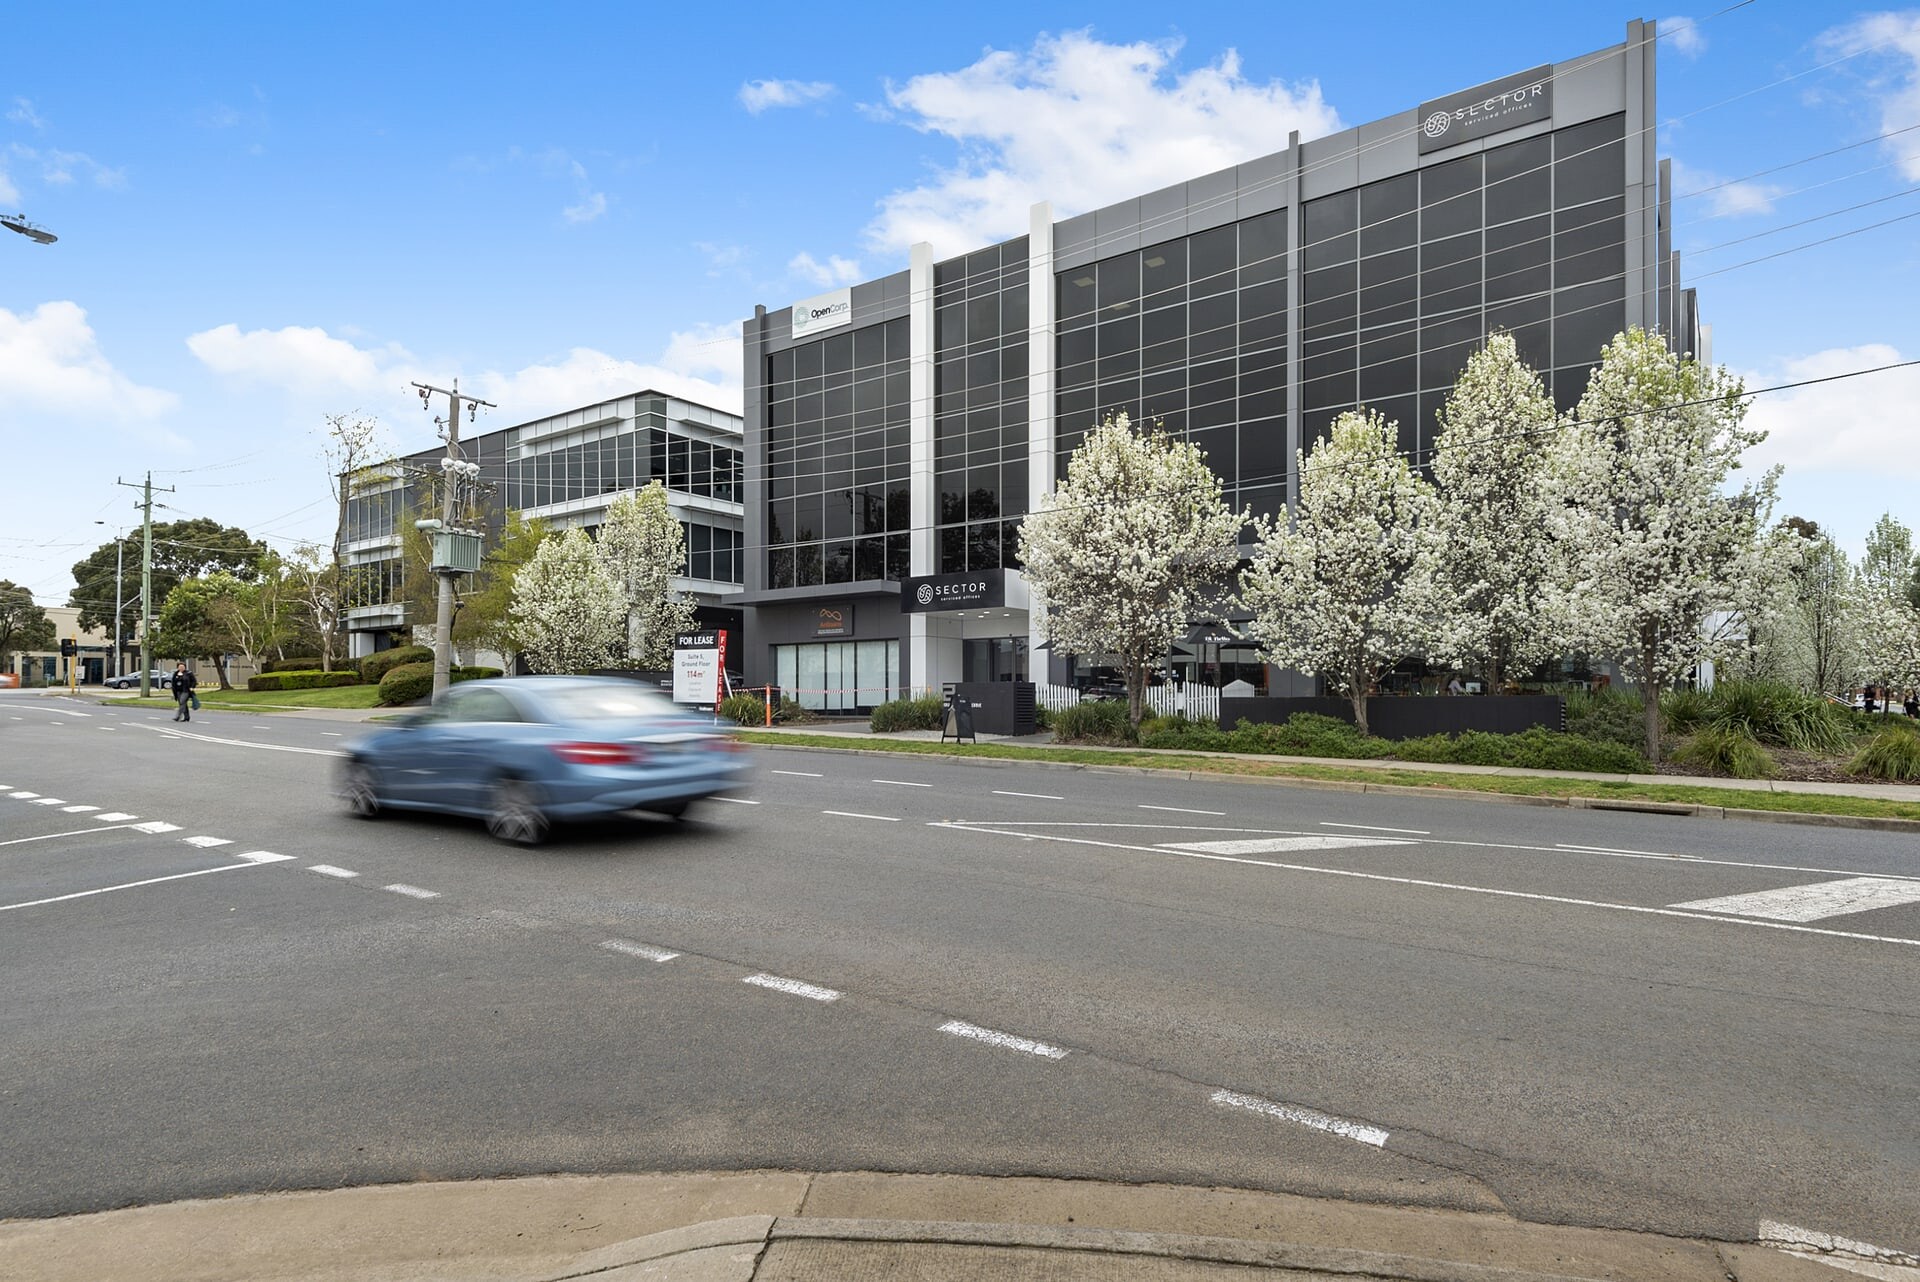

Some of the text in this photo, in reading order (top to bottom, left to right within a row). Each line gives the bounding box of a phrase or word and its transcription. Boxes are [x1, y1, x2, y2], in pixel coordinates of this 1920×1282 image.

[1455, 84, 1542, 119] SECTOR
[1464, 102, 1532, 127] serviced offices
[935, 582, 986, 595] SECTOR
[679, 636, 714, 645] FOR LEASE
